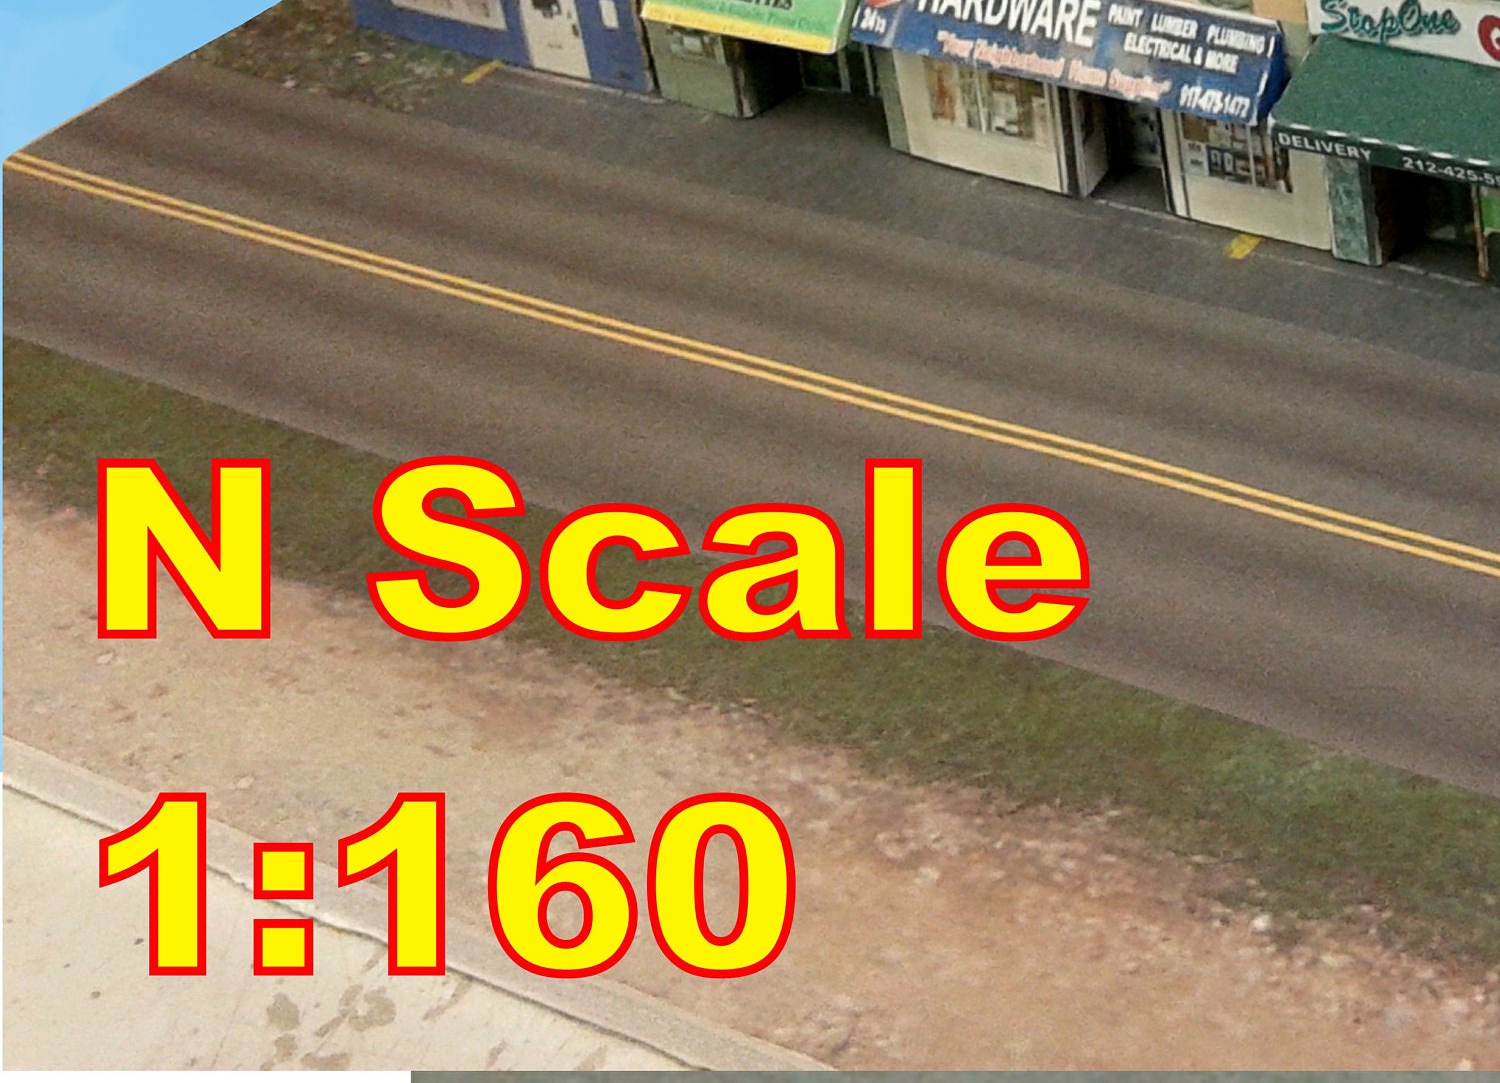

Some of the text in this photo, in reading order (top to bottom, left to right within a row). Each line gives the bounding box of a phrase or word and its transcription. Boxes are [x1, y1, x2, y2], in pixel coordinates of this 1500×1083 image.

[1108, 3, 1145, 28] PAINT
[1123, 32, 1192, 66] ELECTRICAL
[1278, 132, 1372, 162] DELIVERY
